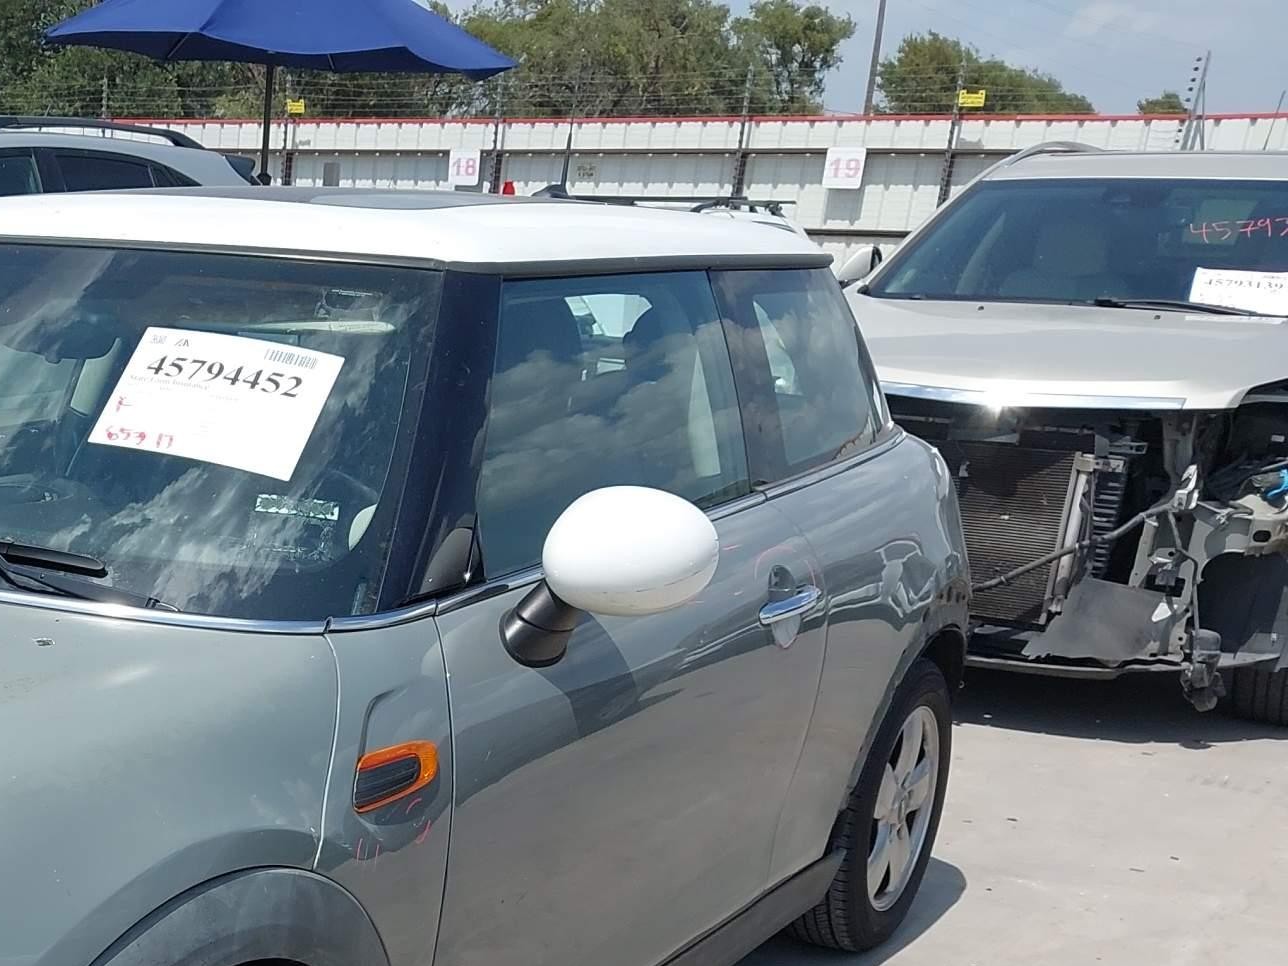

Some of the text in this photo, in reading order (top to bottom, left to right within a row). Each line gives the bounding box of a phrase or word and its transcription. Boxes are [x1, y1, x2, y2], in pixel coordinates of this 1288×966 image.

[452, 157, 477, 177] 18
[830, 157, 861, 179] 19
[146, 354, 304, 398] 45794452
